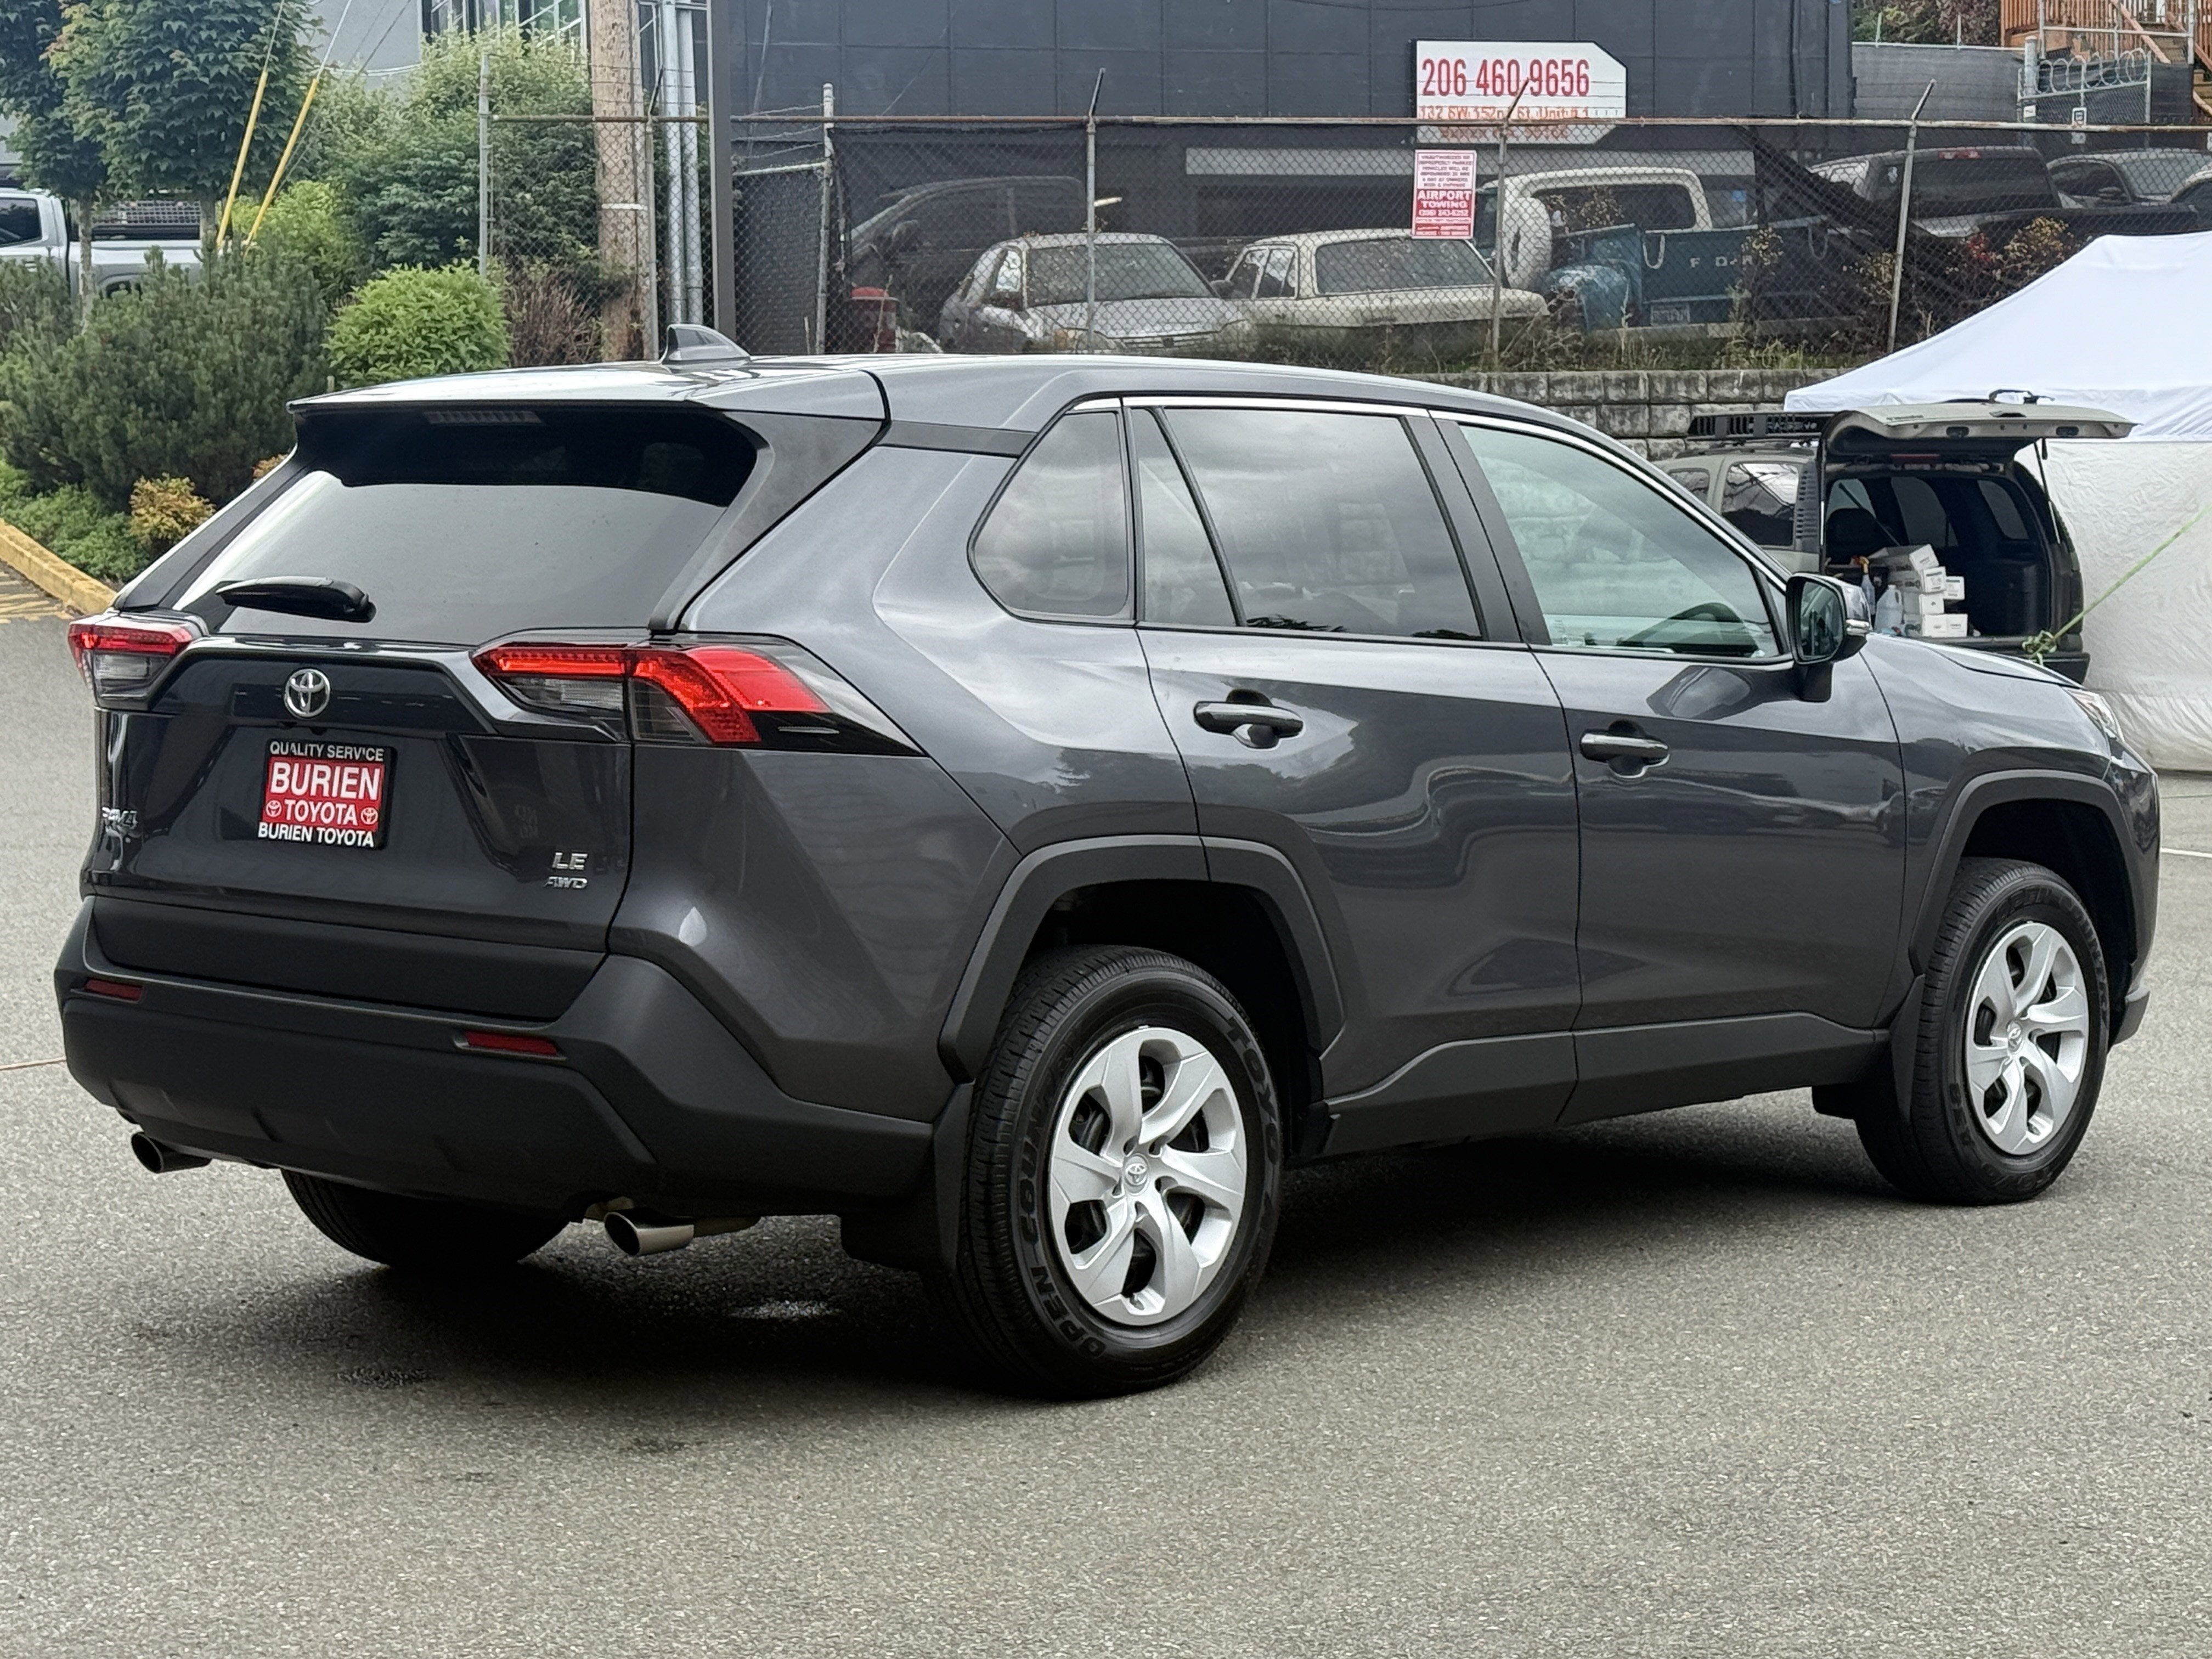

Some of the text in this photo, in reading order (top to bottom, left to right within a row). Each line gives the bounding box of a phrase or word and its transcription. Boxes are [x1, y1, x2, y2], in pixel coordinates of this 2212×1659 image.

[1422, 58, 1589, 97] 206 460 9656
[1417, 190, 1472, 201] AIRPORT
[270, 741, 384, 761] QUALITY SERVICE
[270, 761, 380, 801] BURIEN
[284, 799, 358, 826] TOYOTA
[258, 822, 374, 848] BURIEN TOYOTA
[552, 852, 588, 870] LE
[544, 876, 588, 888] AWD
[1030, 1266, 1106, 1357] OPEN
